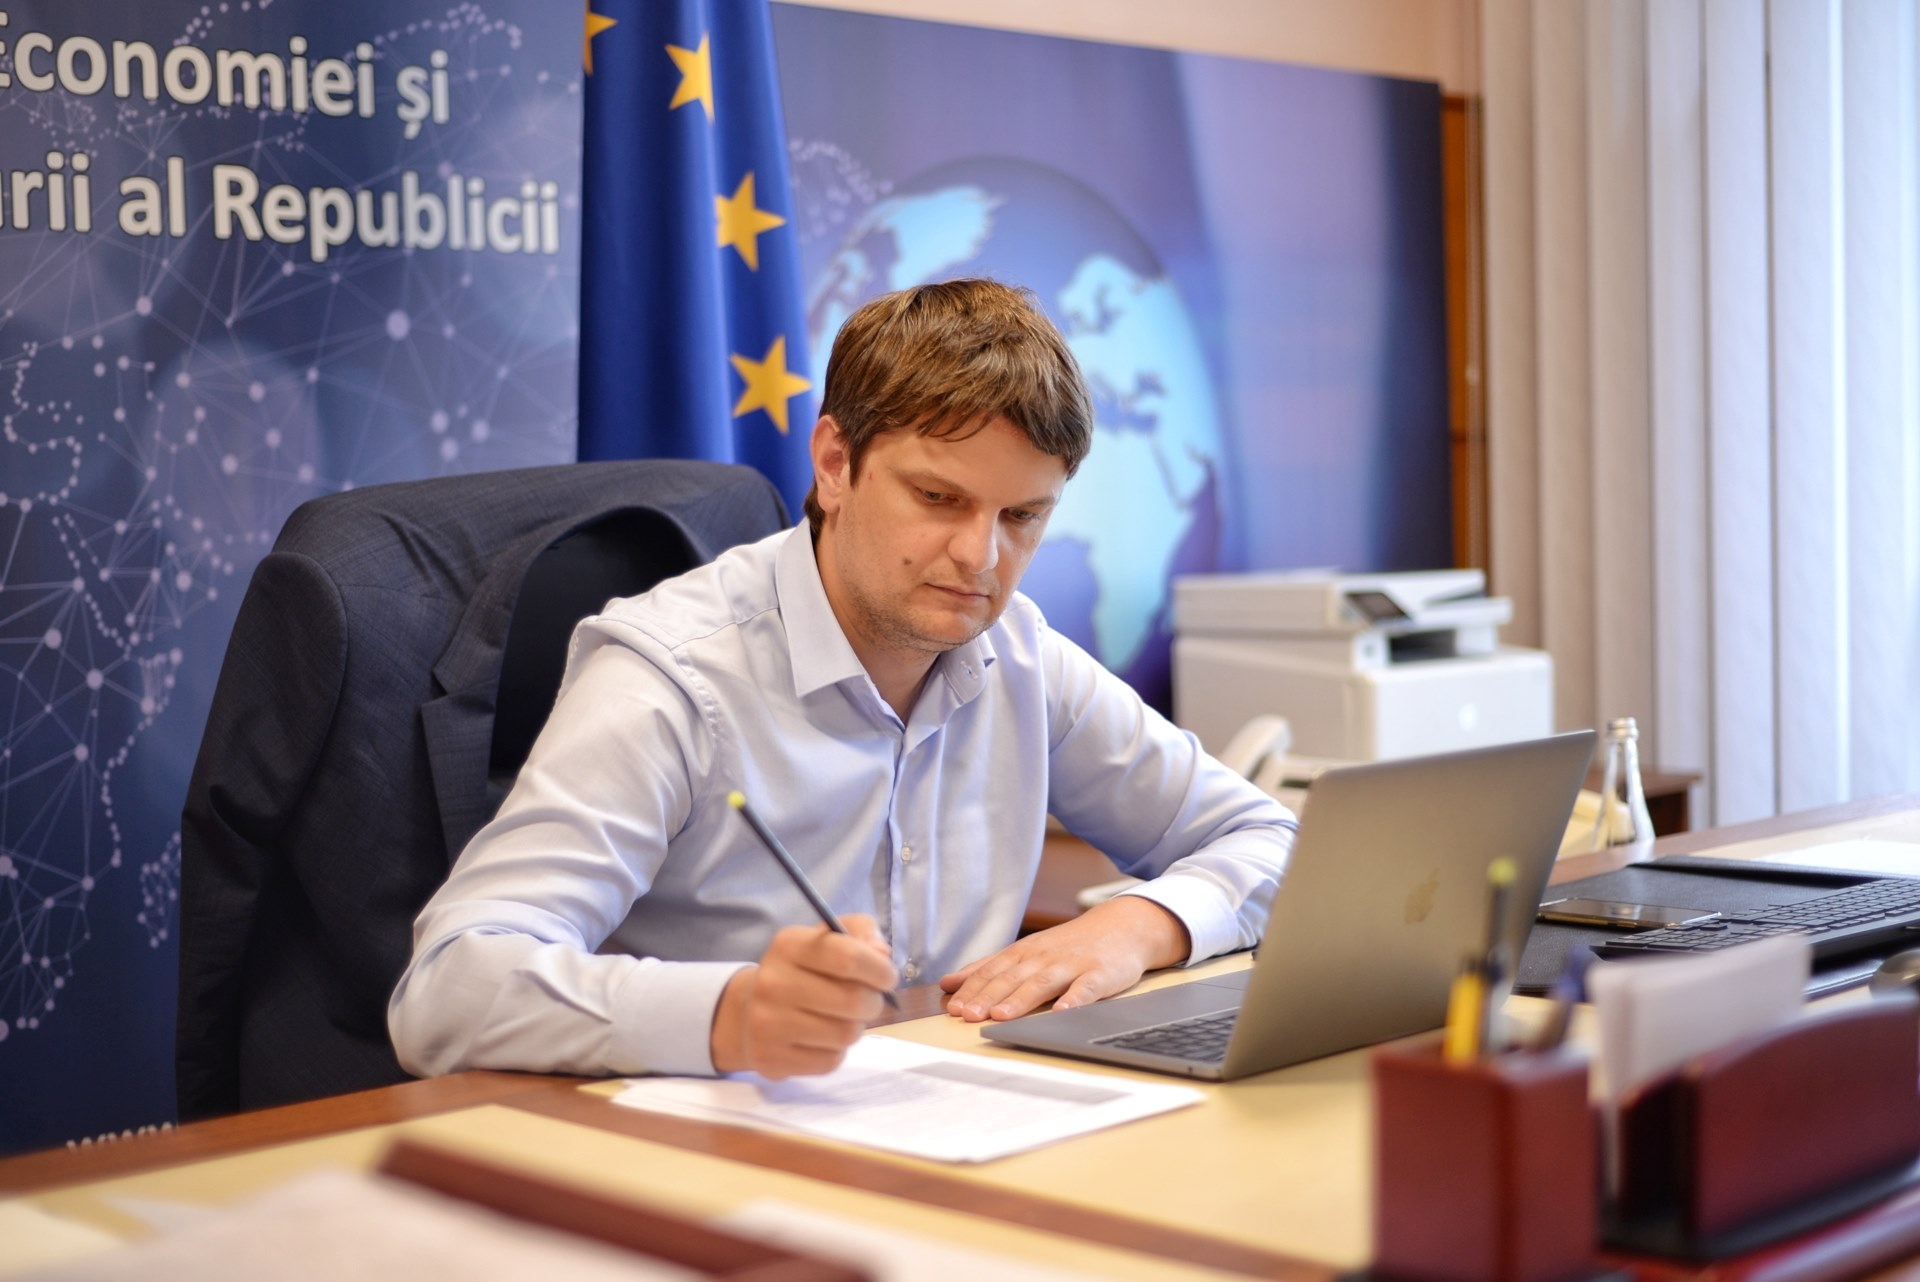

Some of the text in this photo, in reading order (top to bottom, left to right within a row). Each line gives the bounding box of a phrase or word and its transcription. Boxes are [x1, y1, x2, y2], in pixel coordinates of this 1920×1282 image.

[0, 11, 451, 141] conomiei și
[0, 150, 560, 262] rii al Republicii
